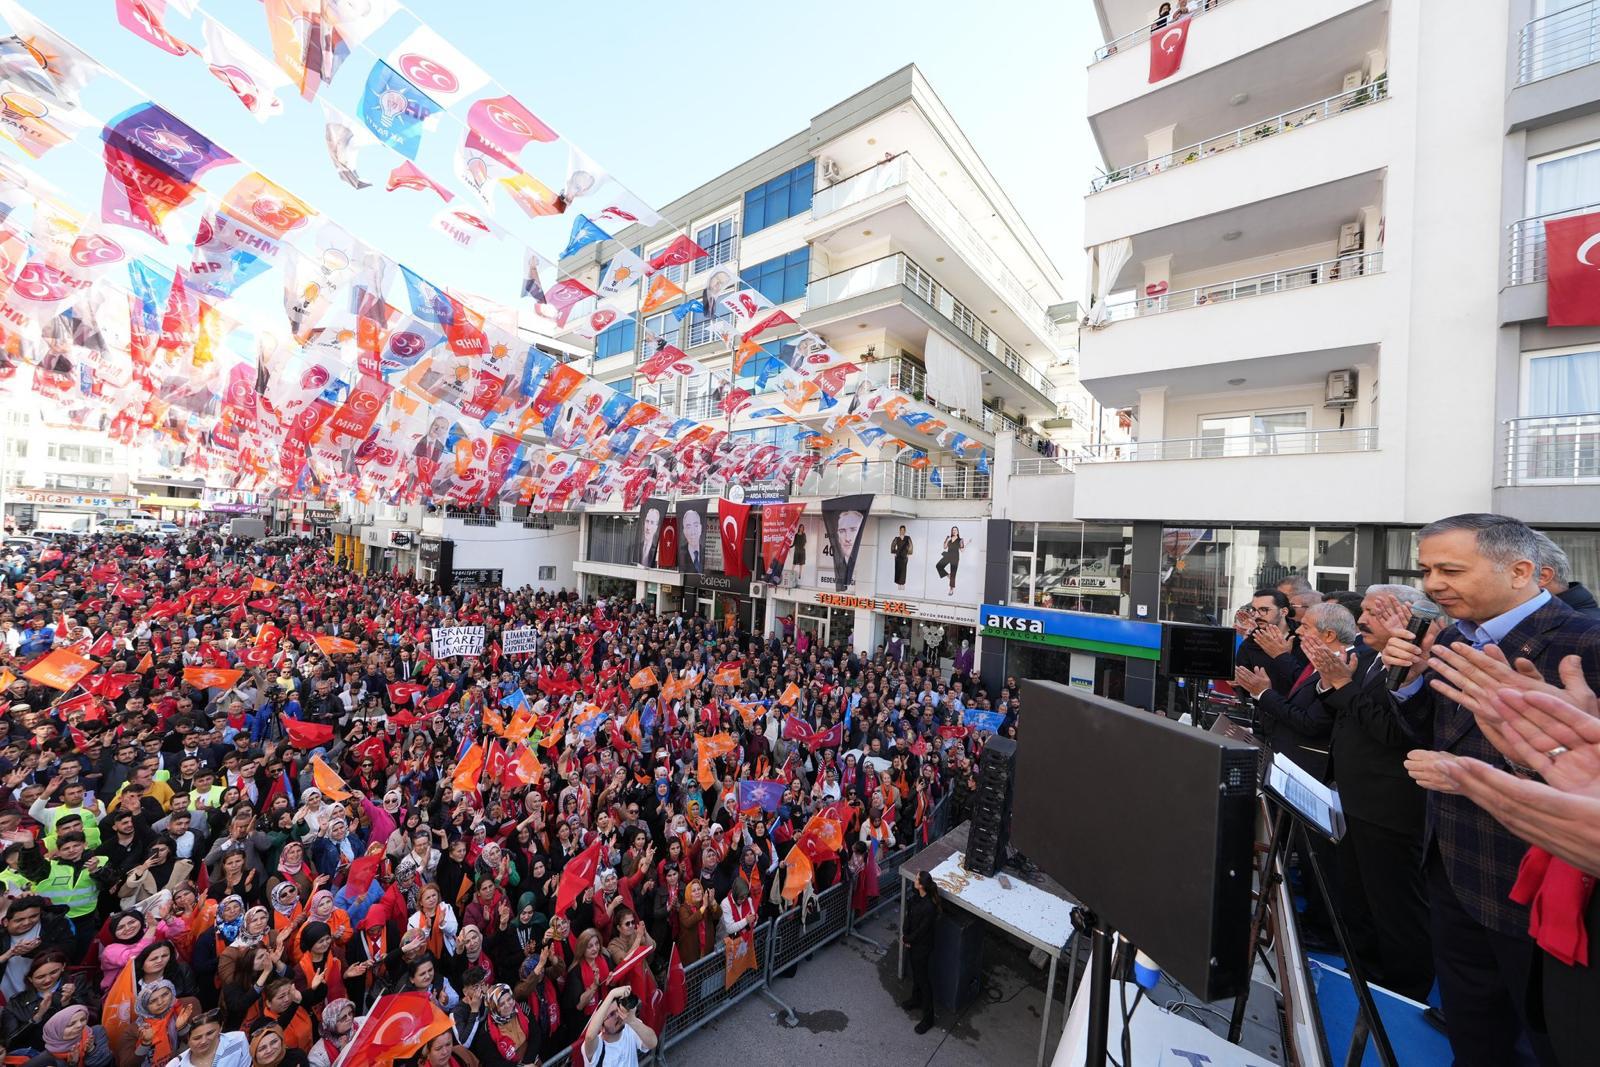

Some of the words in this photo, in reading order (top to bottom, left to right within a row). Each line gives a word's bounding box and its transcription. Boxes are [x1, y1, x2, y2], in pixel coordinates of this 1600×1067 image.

[189, 261, 222, 274] HP
[725, 300, 745, 317] MHP
[820, 377, 836, 392] MHP
[336, 418, 363, 432] MHP
[819, 592, 875, 610] TURUNCU
[883, 600, 911, 616] XXL
[987, 613, 1043, 634] aksa
